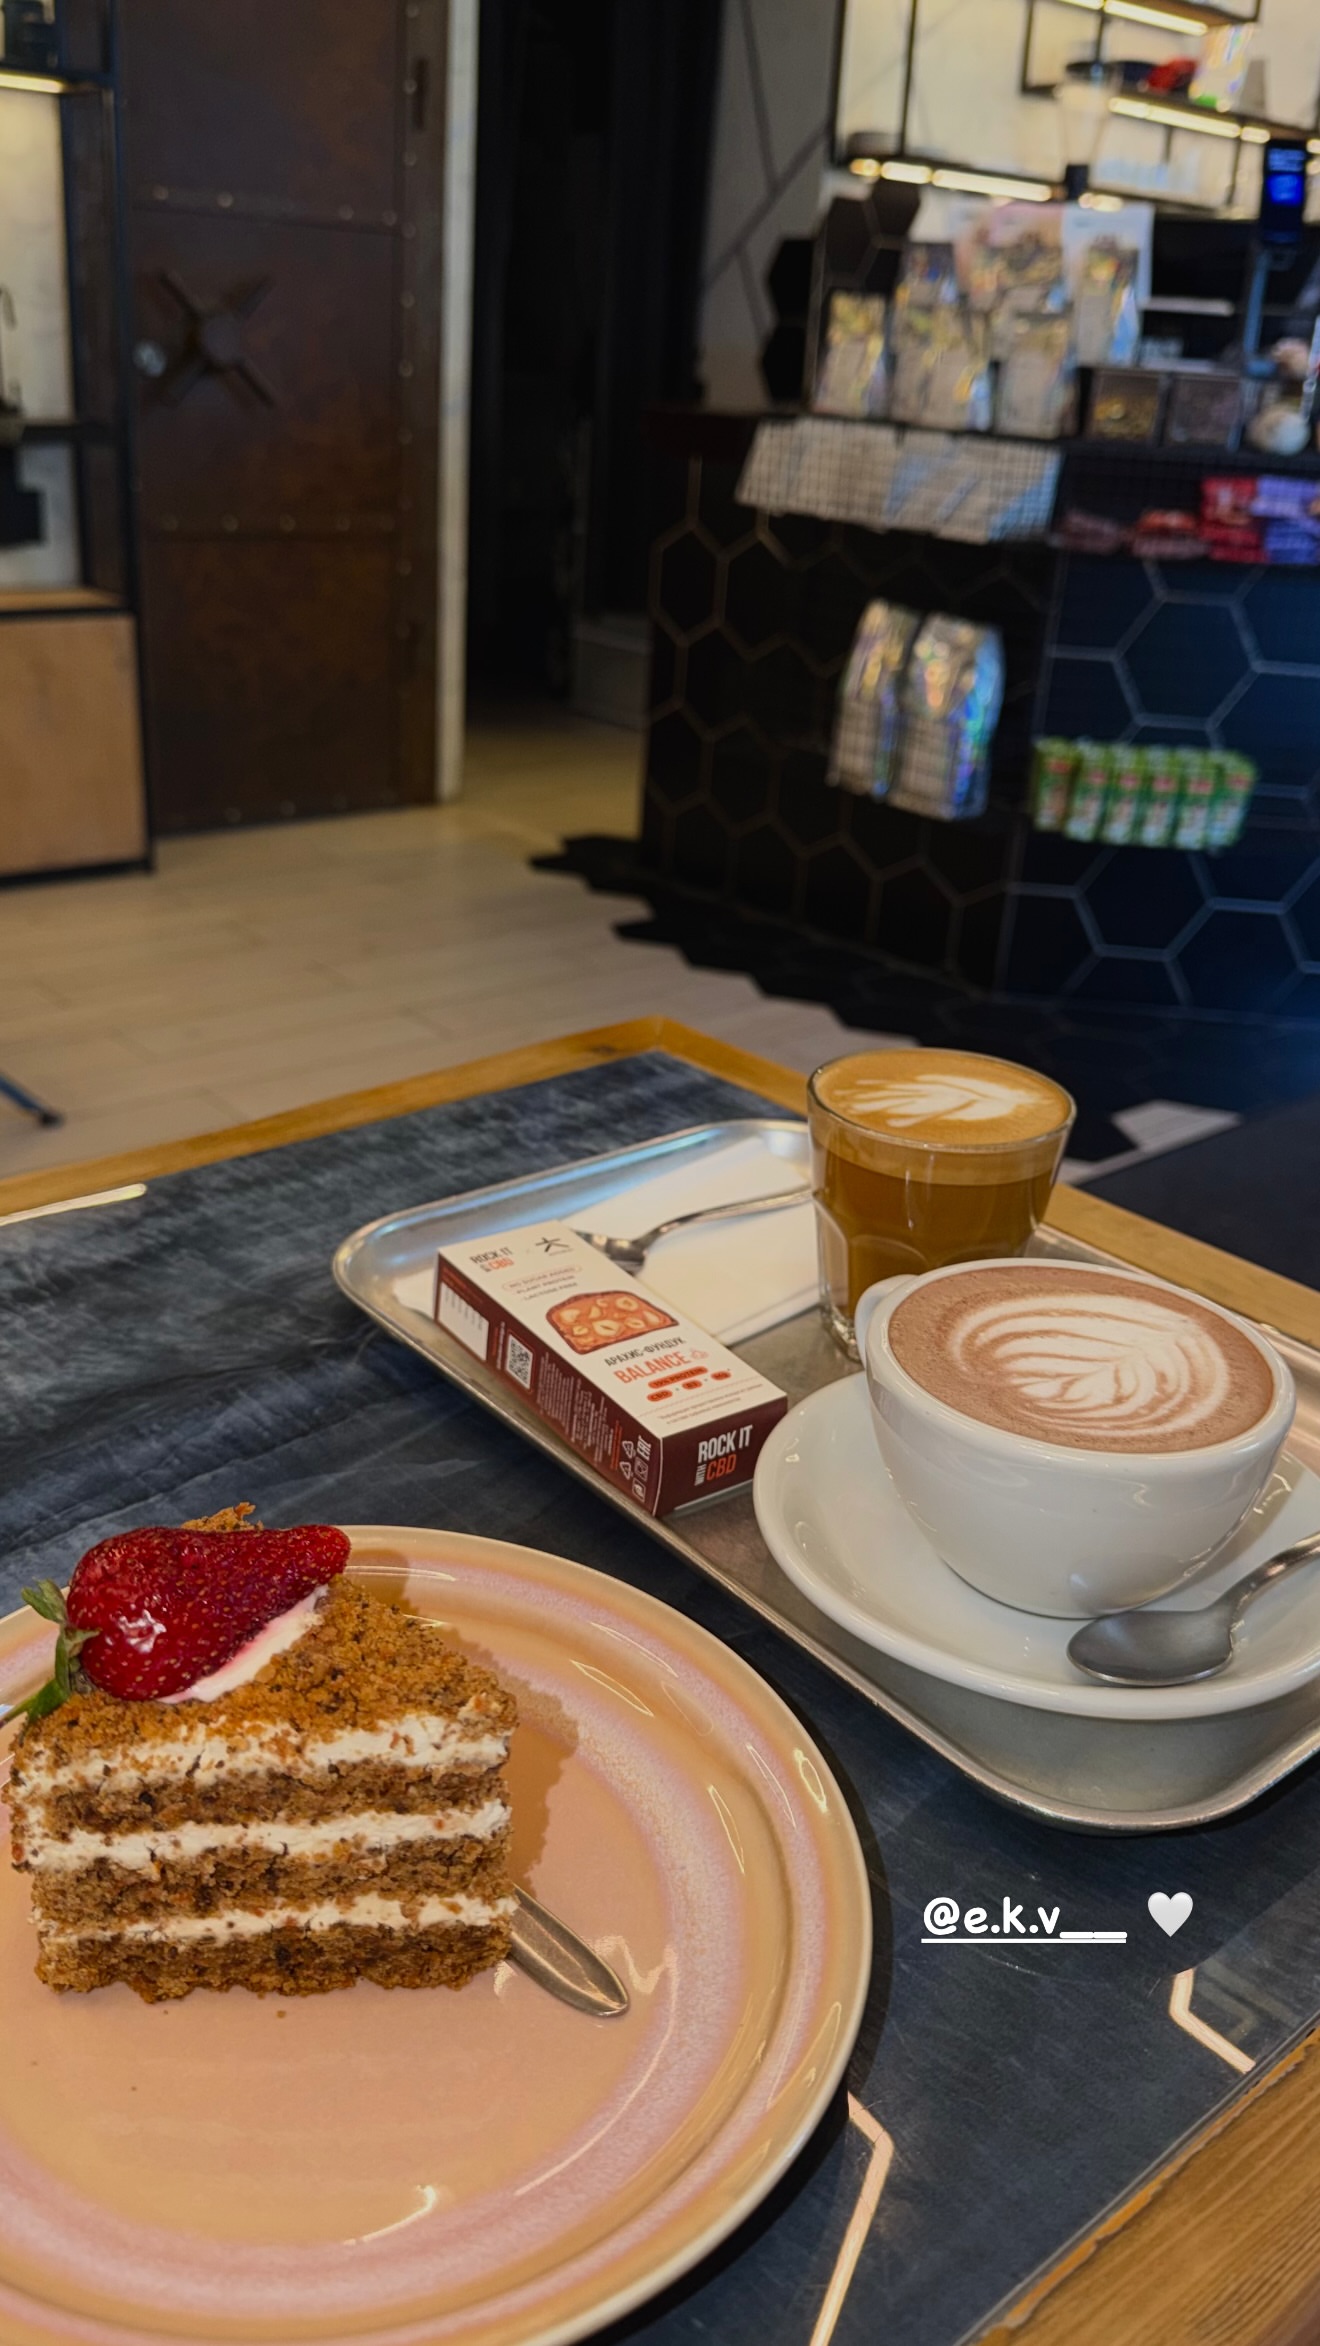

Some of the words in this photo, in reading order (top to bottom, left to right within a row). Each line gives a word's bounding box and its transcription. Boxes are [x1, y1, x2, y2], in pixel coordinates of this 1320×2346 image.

[604, 1336, 687, 1367] АРАХИС-ФУНДУК
[613, 1351, 692, 1384] BALANCE
[698, 1430, 737, 1463] ROCK
[739, 1424, 753, 1449] IT
[706, 1454, 737, 1481] CBD
